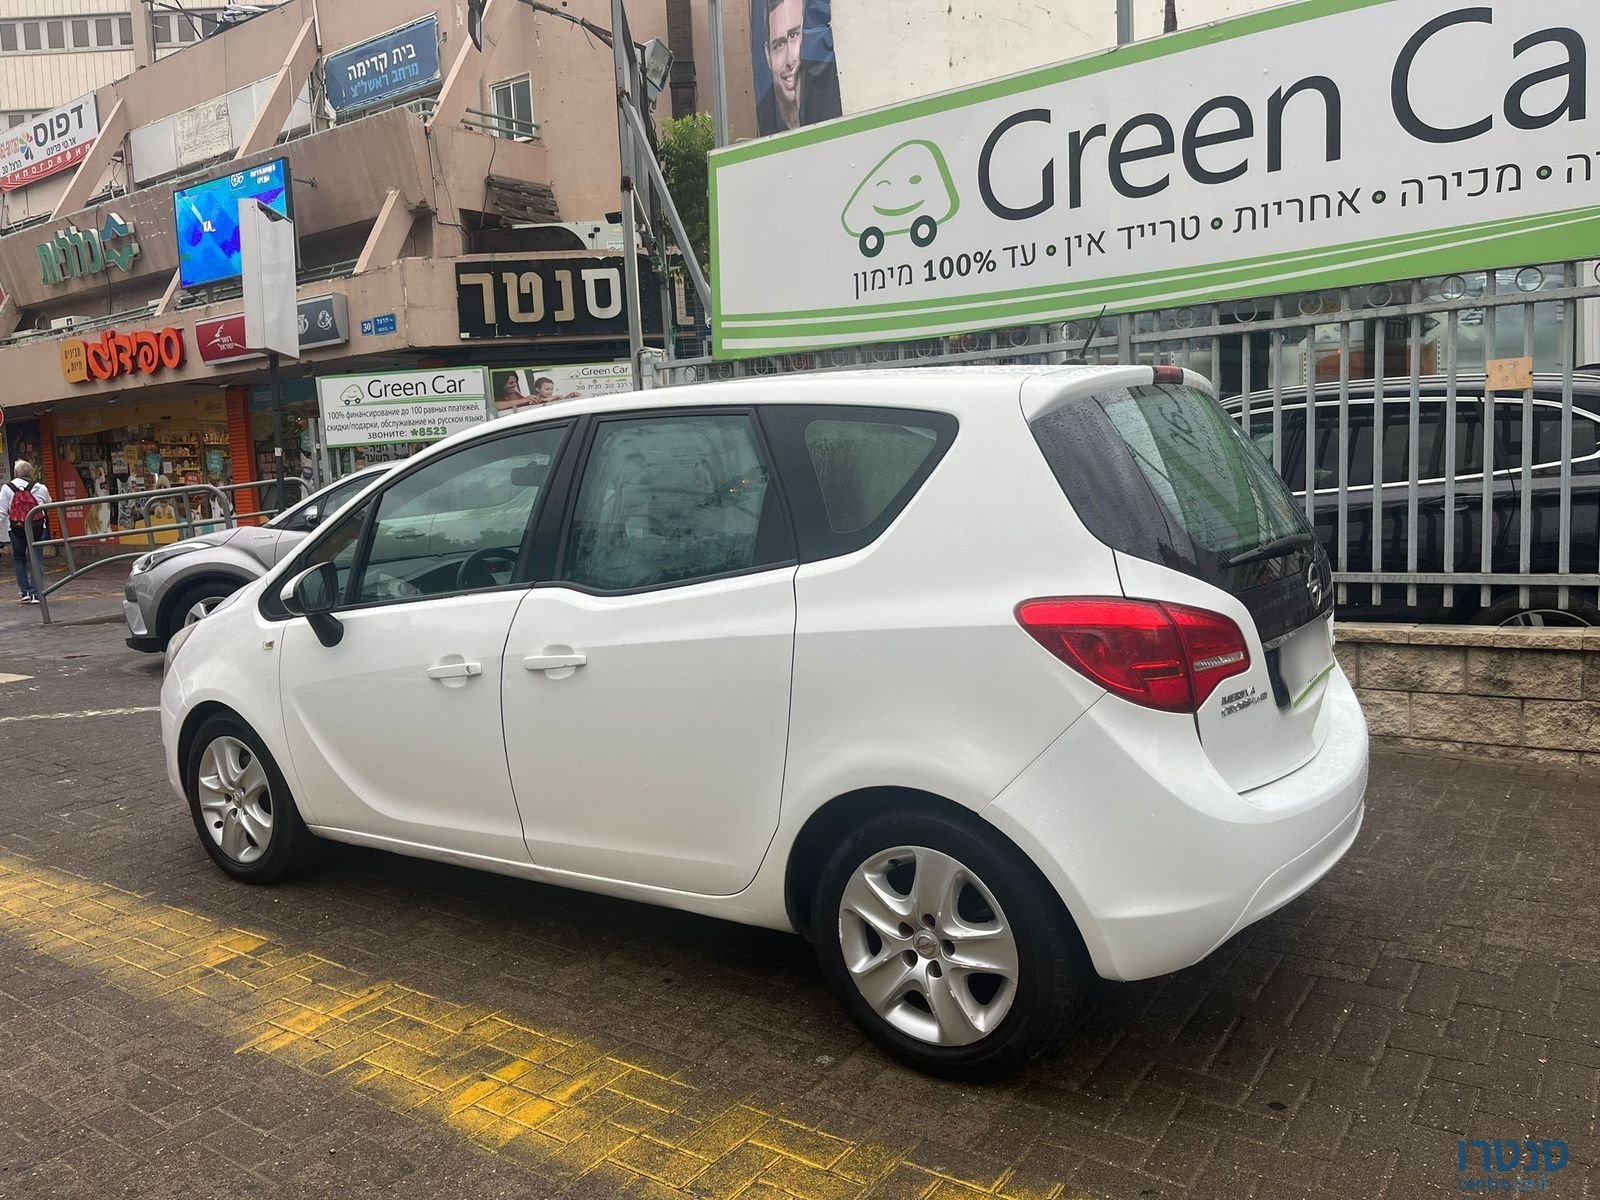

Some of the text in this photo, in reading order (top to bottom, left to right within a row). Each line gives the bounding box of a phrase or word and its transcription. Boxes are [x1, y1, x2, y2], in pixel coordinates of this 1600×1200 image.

[347, 43, 416, 81] בית קדימה
[391, 62, 419, 83] מרחב
[33, 104, 83, 148] דפוס
[977, 74, 1342, 222] Green
[1400, 162, 1522, 208] מכירה
[1232, 186, 1362, 234] אחריות
[1064, 229, 1107, 267] אין
[1117, 214, 1202, 251] טרייד
[36, 226, 102, 286] כללית
[923, 248, 997, 284] 100%
[1002, 242, 1038, 270] עד
[459, 267, 623, 325] סנטר
[852, 263, 914, 300] מימון
[362, 322, 371, 333] 30
[367, 375, 466, 399] Green Car
[581, 366, 629, 376] Green Car
[346, 408, 400, 420] финансирование
[400, 407, 410, 416] до
[411, 406, 423, 415] 100
[424, 406, 447, 416] равных
[380, 418, 427, 430] обслуживание
[428, 418, 436, 426] на
[437, 416, 464, 427] русском
[367, 428, 408, 440] звоните:
